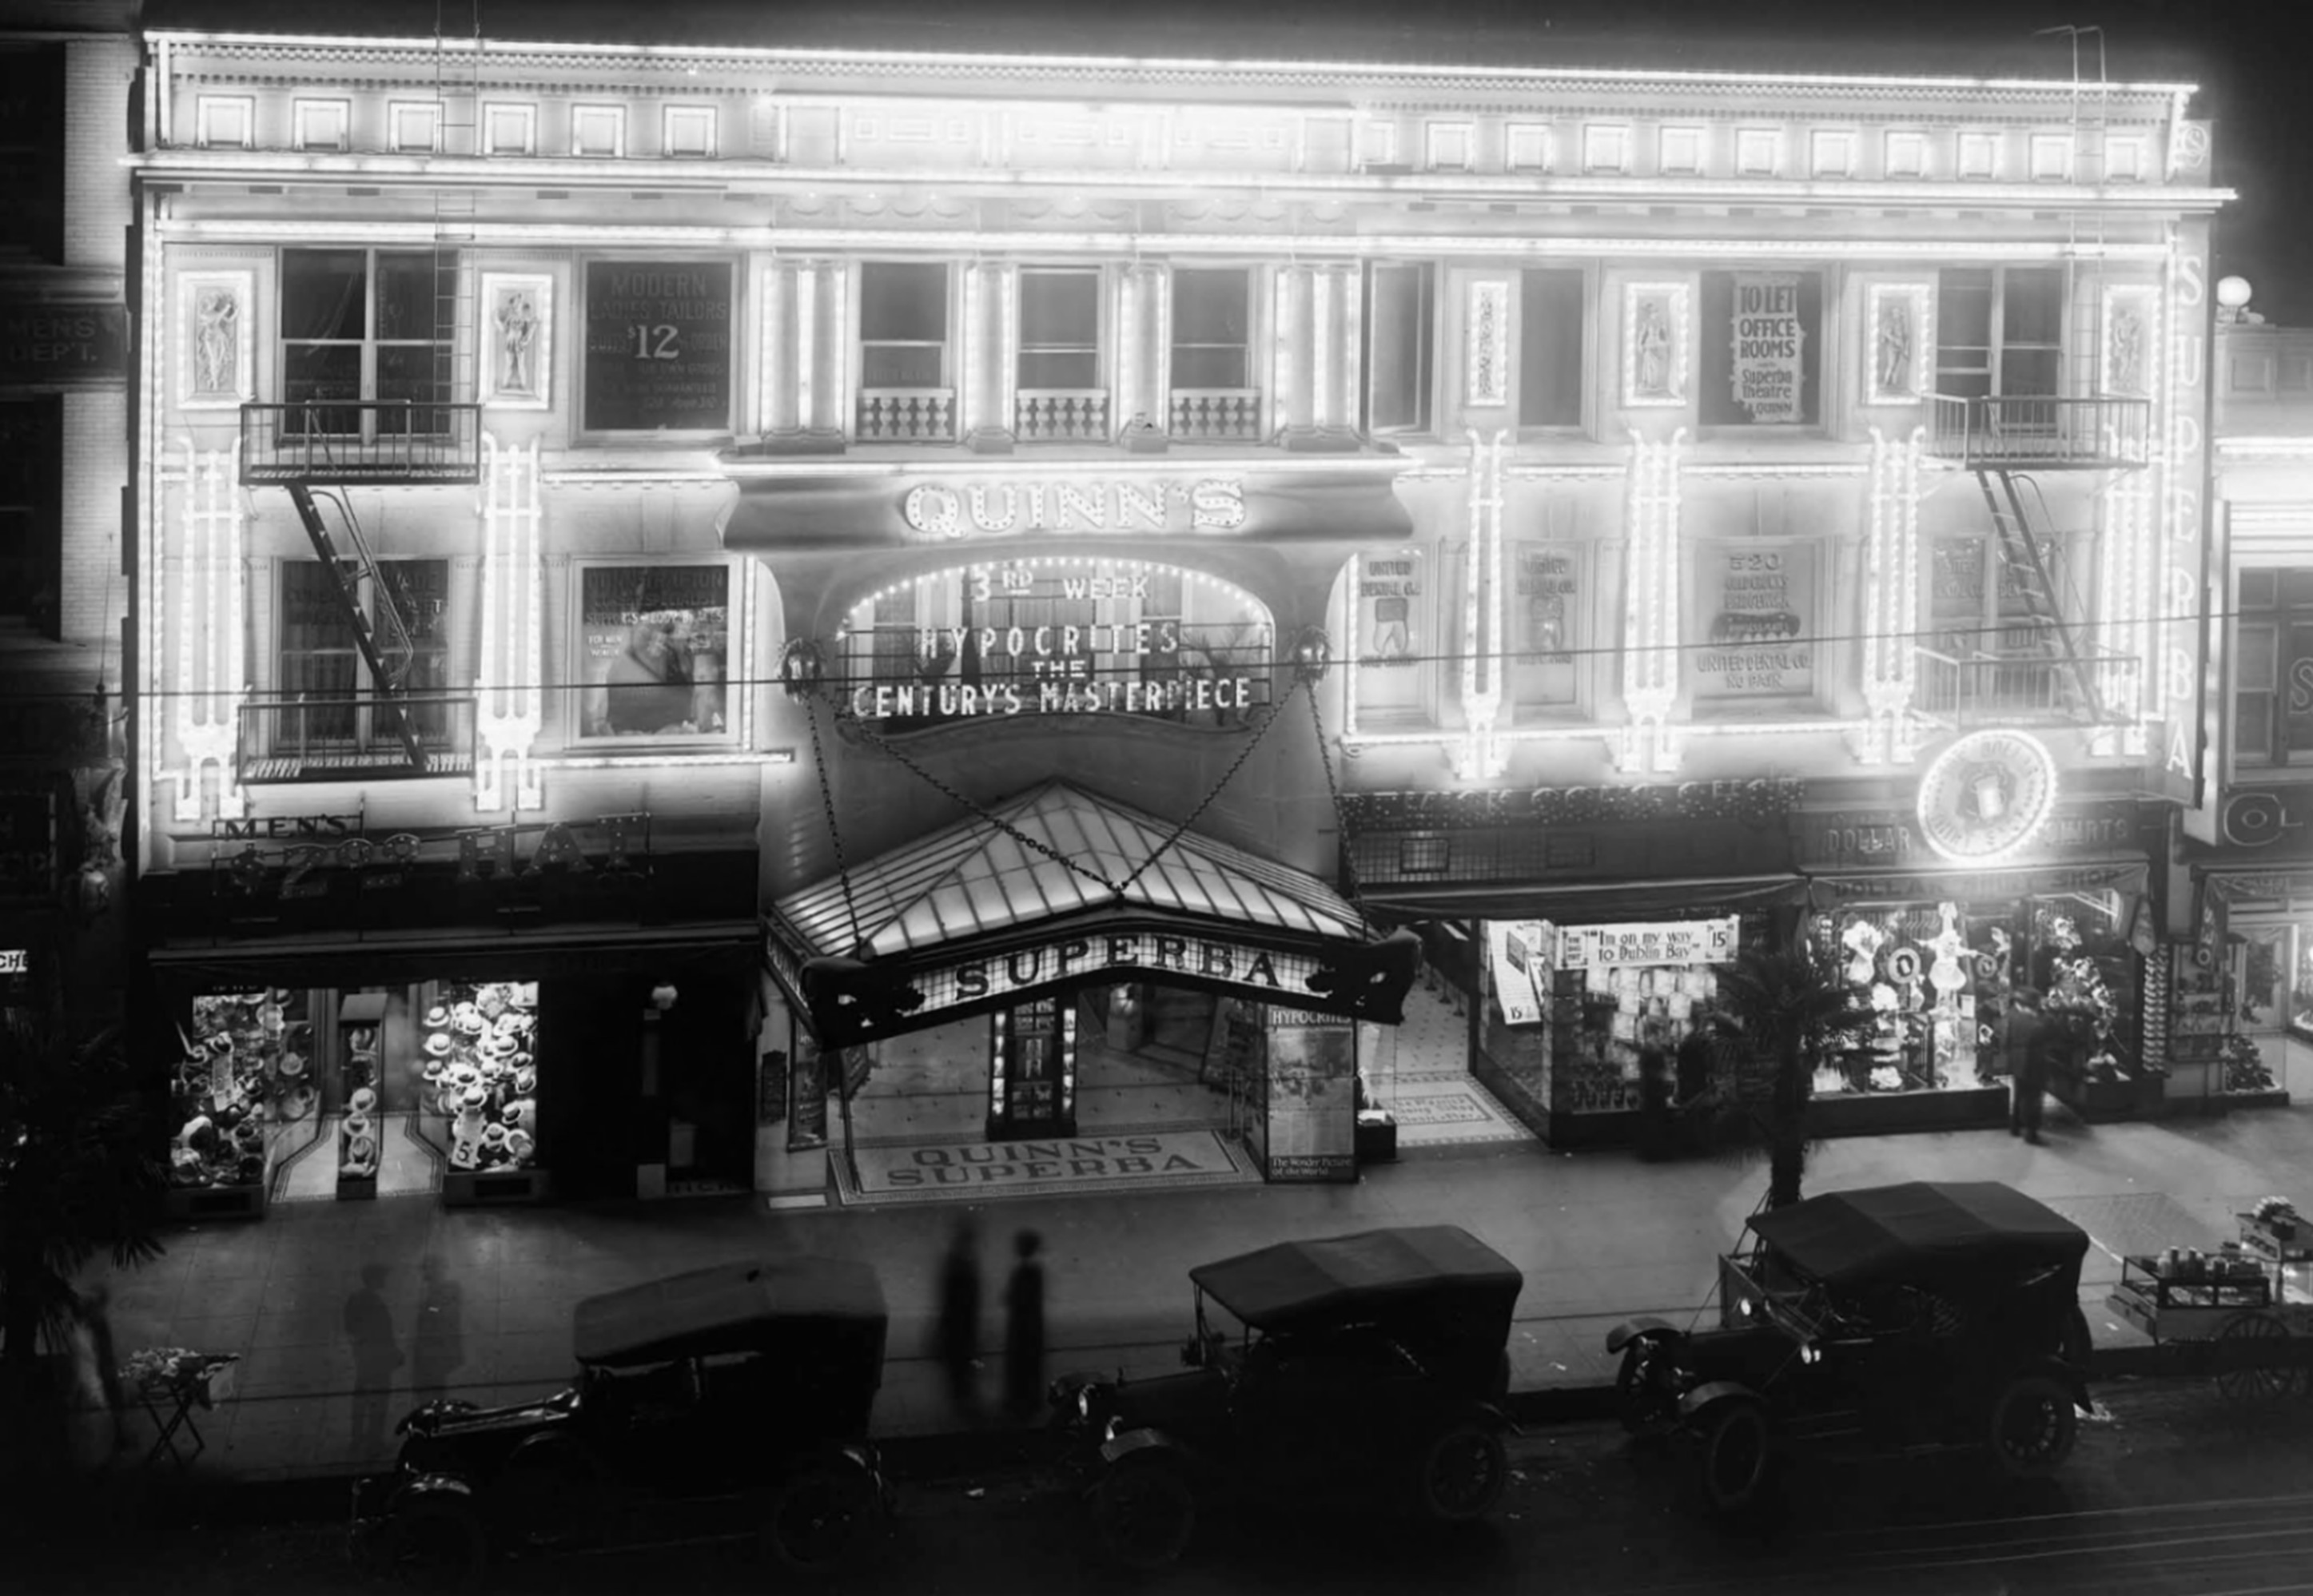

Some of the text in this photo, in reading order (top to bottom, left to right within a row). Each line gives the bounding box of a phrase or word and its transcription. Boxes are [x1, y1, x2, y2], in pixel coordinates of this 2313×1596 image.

[611, 272, 707, 297] MODERN
[659, 300, 727, 320] TAILORS
[1739, 285, 1796, 313] TO LET
[1738, 318, 1796, 338] OFFICE
[627, 323, 680, 359] $12
[1739, 339, 1796, 359] ROOMS
[1742, 368, 1793, 385] Superba
[1742, 385, 1793, 399] Theatre
[904, 480, 1249, 538] QUINN'S
[2166, 255, 2203, 780] SUPERBA
[1062, 574, 1151, 600] WEEK
[919, 622, 1180, 659] HYPOCRITES
[1030, 659, 1086, 679] THE
[1696, 655, 1744, 673] UNITED
[1746, 653, 1790, 671] DENTAL
[852, 677, 1251, 718] CENTURY'S MASTERPIECE
[225, 815, 345, 841] MEN'S
[1826, 826, 1912, 852] DOLLAR
[455, 812, 644, 884] HAT
[1620, 933, 1636, 945] on
[1711, 931, 1727, 948] 15
[1598, 948, 1614, 962] to
[1619, 945, 1660, 961] Dublin
[954, 937, 1280, 1002] SUPERBA
[911, 1136, 1165, 1168] QUINN'S
[1272, 1157, 1288, 1167] The
[887, 1153, 1206, 1187] SUPERBA
[1300, 1168, 1330, 1177] World
